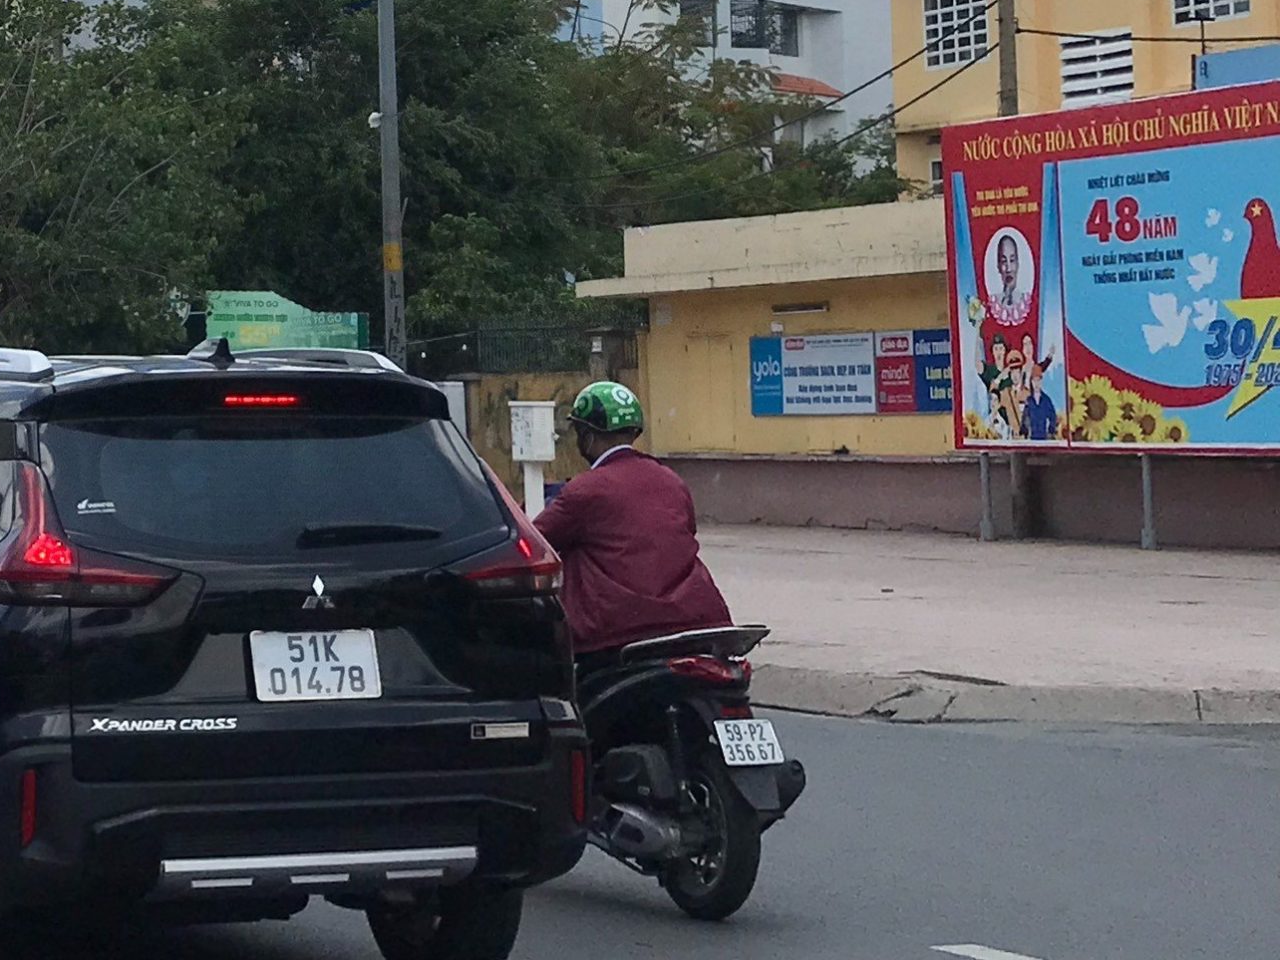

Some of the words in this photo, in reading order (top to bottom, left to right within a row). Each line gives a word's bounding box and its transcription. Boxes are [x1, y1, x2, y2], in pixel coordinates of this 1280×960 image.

[963, 132, 1001, 161] NƯỚC
[1003, 130, 1041, 159] CỘNG
[1045, 124, 1076, 152] HÒA
[1078, 119, 1099, 148] XÃ
[1102, 116, 1129, 147] HỘI
[1132, 107, 1165, 142] CHỦ
[1168, 104, 1220, 137] NGHĨA
[1223, 98, 1263, 132] VIỆT
[1085, 196, 1141, 243] 48
[1143, 214, 1177, 240] NĂM
[753, 354, 780, 382] yola
[1204, 363, 1241, 387] 1975
[287, 634, 339, 663] 51K
[269, 665, 366, 696] 014.78
[87, 717, 176, 732] XPANDER
[179, 716, 238, 731] CROSS
